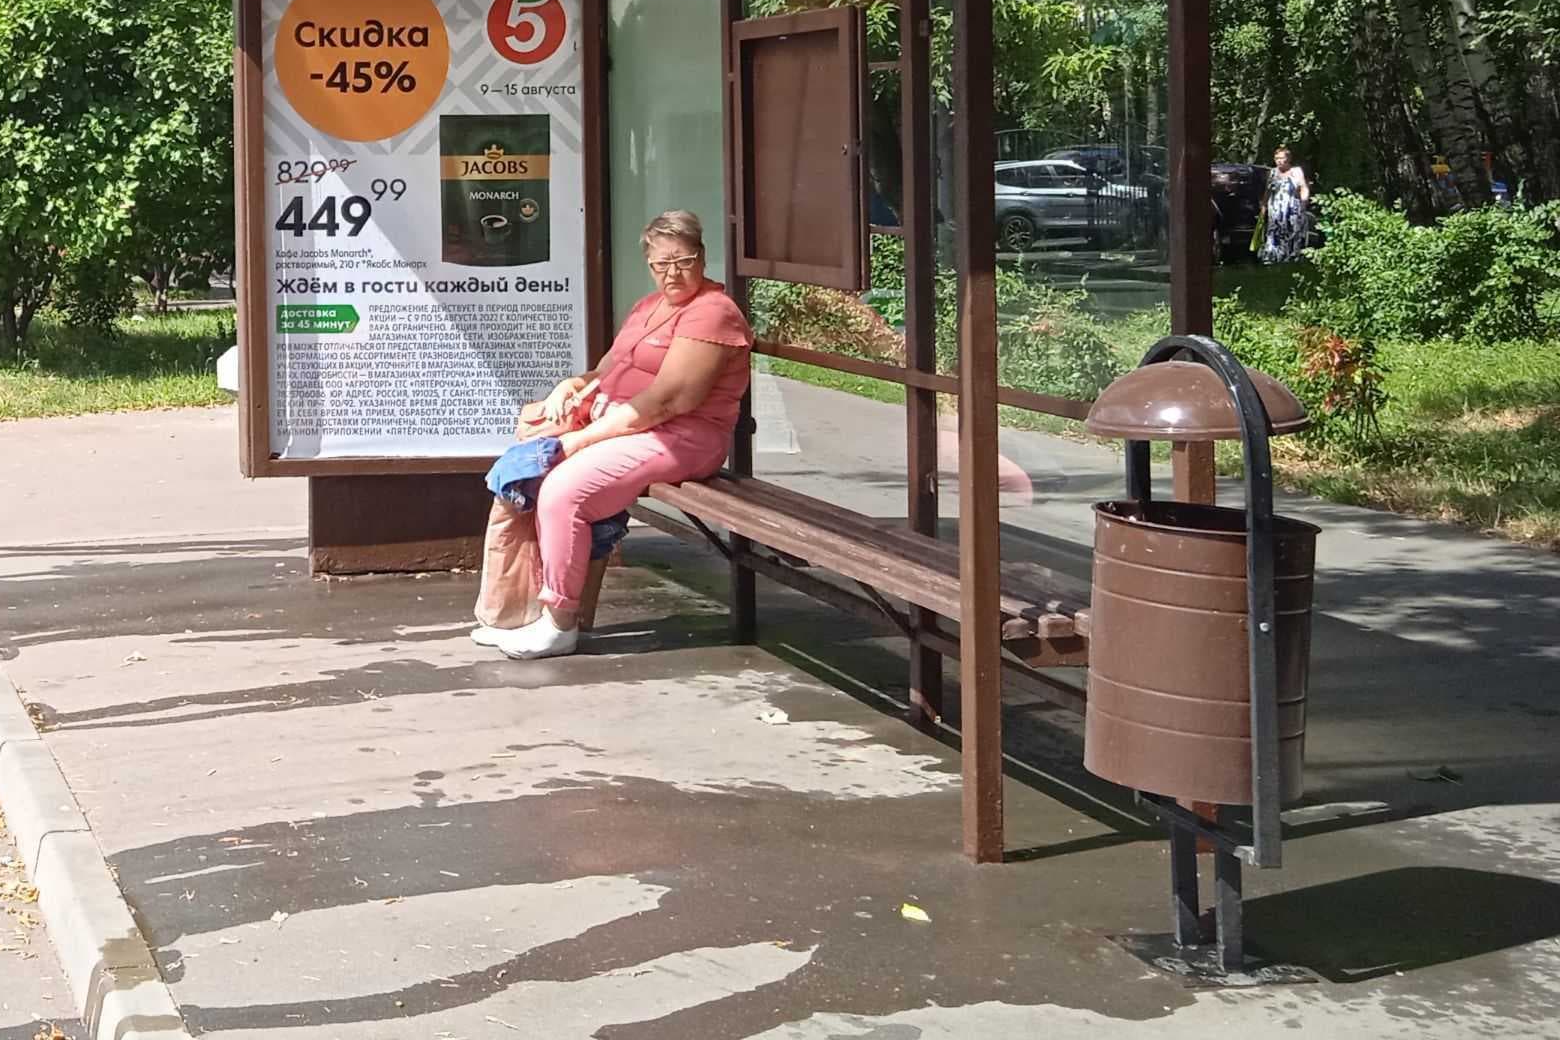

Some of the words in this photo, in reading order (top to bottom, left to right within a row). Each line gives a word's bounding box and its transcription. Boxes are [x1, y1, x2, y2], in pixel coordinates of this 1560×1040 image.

[295, 20, 429, 48] Скидка
[310, 61, 417, 93] -45%
[480, 84, 489, 96] 9
[505, 84, 518, 96] 15
[521, 85, 576, 99] августа
[461, 160, 528, 177] JACOBS
[469, 191, 520, 201] MONARCH
[275, 195, 372, 238] 449
[371, 178, 407, 201] 99
[299, 249, 329, 259] Jacobs
[340, 260, 355, 270] 210
[393, 260, 428, 270] Монарх
[276, 277, 338, 294] Ждём
[345, 281, 356, 294] в
[362, 281, 418, 294] гости
[425, 276, 508, 293] каждый
[515, 276, 569, 293] день!
[368, 304, 429, 312] ПРЕДЛОЖЕНИЕ
[430, 304, 476, 312] ДЕЙСТВУЕТ
[487, 304, 519, 312] ПЕРИОД
[520, 303, 573, 312] ПРОВЕДЕНИЯ
[280, 309, 338, 319] доставка
[369, 314, 397, 322] АКЦИИ
[421, 314, 432, 322] ПО
[434, 314, 443, 322] 15
[444, 314, 478, 322] АВГУСТА
[480, 314, 498, 322] 2022
[506, 314, 558, 322] КОЛИЧЕСТВО
[280, 321, 294, 329] за
[297, 320, 311, 329] 45
[313, 320, 352, 332] минут
[369, 323, 390, 331] ВАРА
[450, 323, 478, 331] АКЦИЯ
[481, 323, 523, 331] ПРОХОДИТ
[526, 323, 537, 331] НЕ
[540, 323, 551, 331] ВО
[553, 323, 573, 331] ВСЕХ
[369, 333, 417, 341] МАГАЗИНАХ
[420, 333, 461, 341] ТОРГОВОЙ
[487, 333, 547, 341] ИЗОБРАЖЕНИЕ
[294, 343, 323, 351] МОЖЕТ
[324, 343, 375, 351] ОТЛИЧАТЬСЯ
[376, 343, 386, 351] ОТ
[387, 343, 460, 351] ПРЕДСТАВЛЕННЫХ
[469, 342, 515, 350] МАГАЗИНАХ
[340, 352, 351, 360] ОБ
[353, 352, 417, 360] АССОРТИМЕНТЕ
[420, 352, 497, 360] (РАЗНОВИДНОСТЯХ
[499, 352, 533, 360] ВКУСОВ)
[478, 361, 492, 369] ВСЕ
[493, 361, 515, 369] ЦЕНЫ
[516, 361, 554, 369] УКАЗАНЫ
[359, 399, 408, 407] УКАЗАННОЕ
[410, 399, 438, 407] ВРЕМЯ
[440, 399, 484, 407] ДОСТАВКИ
[487, 399, 498, 407] НЕ
[298, 409, 318, 417] СЕБЯ
[320, 409, 349, 417] ВРЕМЯ
[351, 409, 363, 417] НА
[399, 408, 447, 416] ОБРАБОТКУ
[457, 408, 479, 416] СБОР
[420, 418, 471, 426] ПОДРОБНЫЕ
[323, 428, 382, 436] ПРИЛОЖЕНИИ
